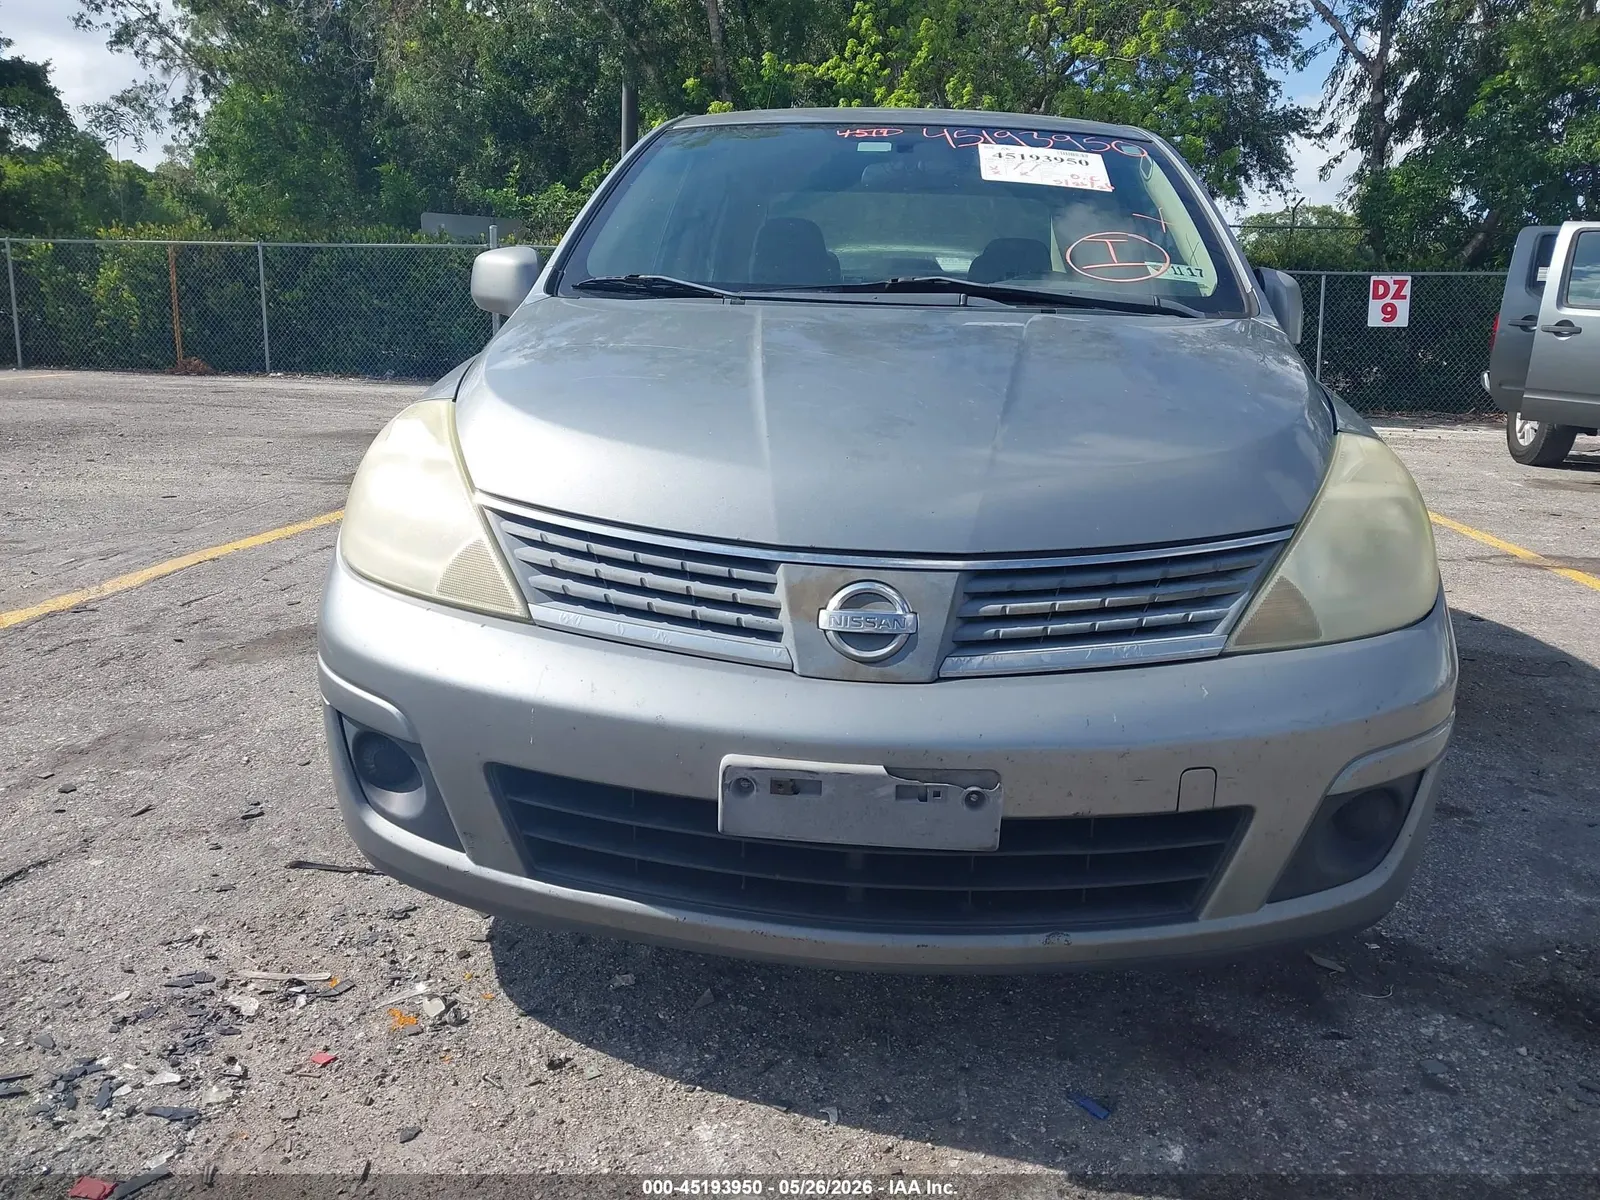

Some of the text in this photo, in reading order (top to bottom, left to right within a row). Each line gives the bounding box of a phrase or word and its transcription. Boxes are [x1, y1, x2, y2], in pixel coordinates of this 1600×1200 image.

[922, 127, 1149, 158] 45193950
[991, 151, 1090, 168] 45193950
[1186, 267, 1204, 278] 17
[1371, 279, 1410, 301] DZ
[1380, 302, 1398, 323] 9
[828, 614, 908, 631] NISSAN
